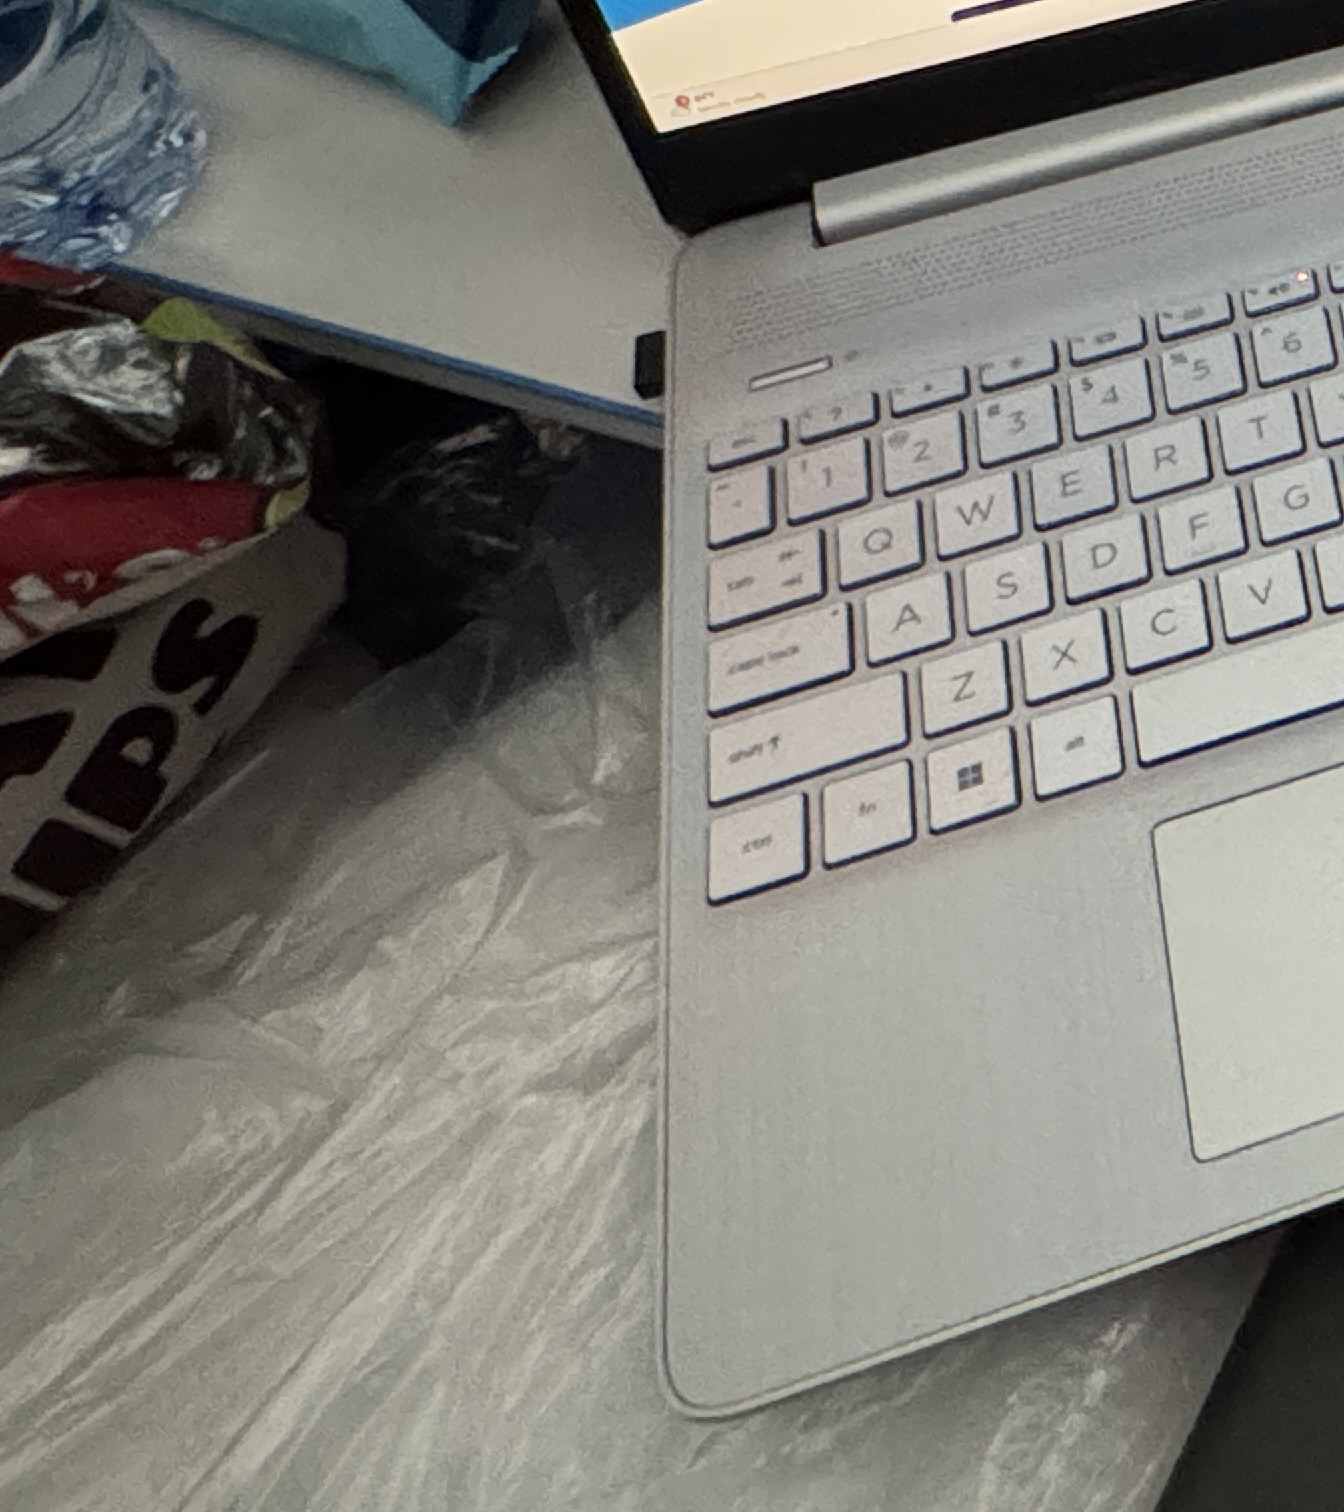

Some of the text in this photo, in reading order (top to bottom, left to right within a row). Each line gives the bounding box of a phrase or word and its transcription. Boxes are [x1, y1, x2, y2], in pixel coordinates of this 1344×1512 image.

[1248, 416, 1270, 439] T
[1153, 443, 1177, 470] R
[1060, 470, 1083, 498] E
[1282, 483, 1310, 510] G
[957, 496, 995, 526] W
[862, 527, 895, 554] Q
[1091, 542, 1118, 570] D
[996, 573, 1019, 599] S
[893, 604, 923, 632] A
[0, 596, 263, 928] IPS
